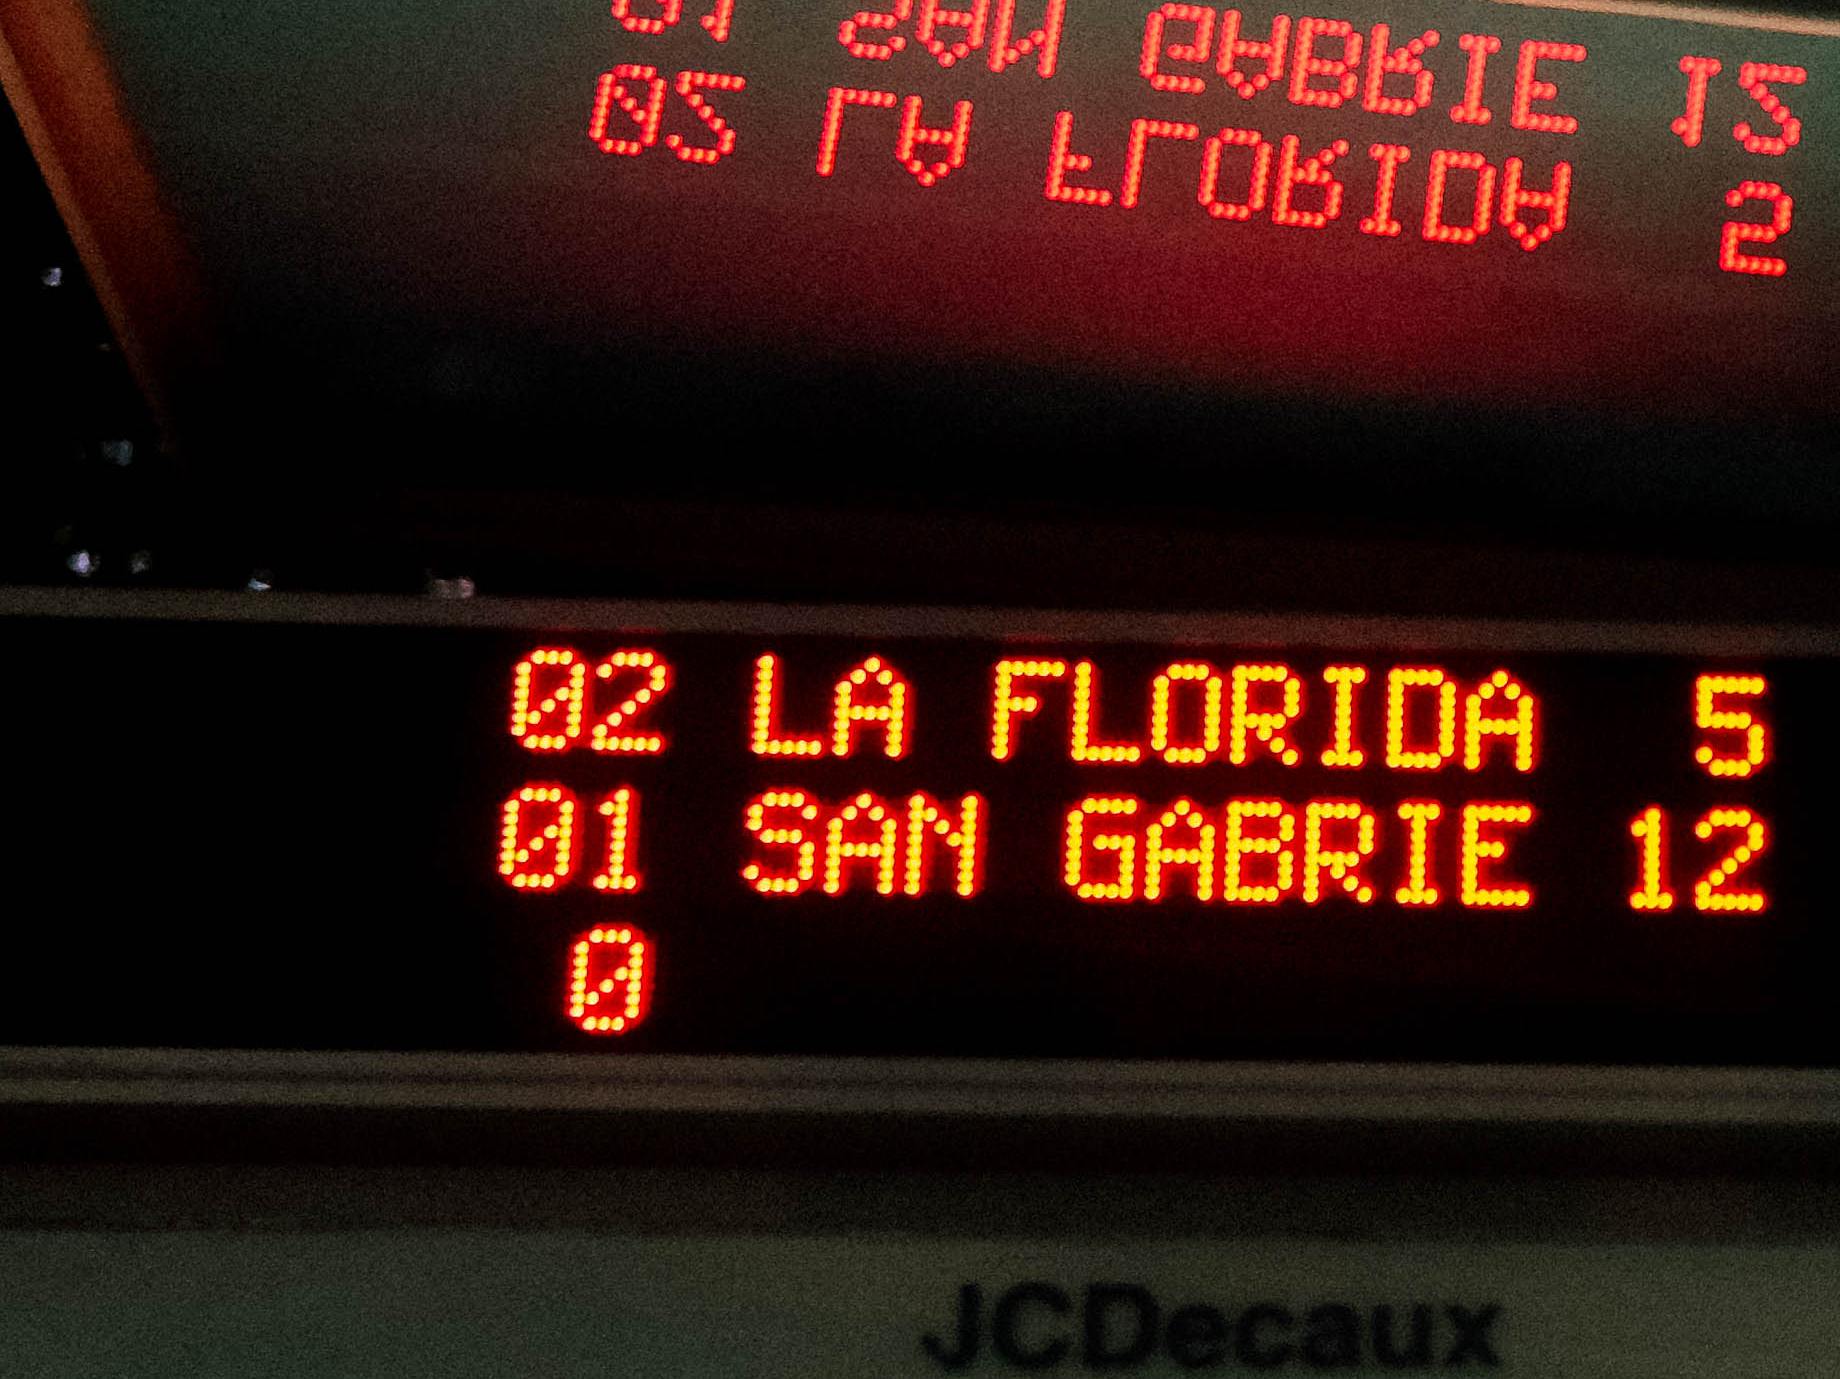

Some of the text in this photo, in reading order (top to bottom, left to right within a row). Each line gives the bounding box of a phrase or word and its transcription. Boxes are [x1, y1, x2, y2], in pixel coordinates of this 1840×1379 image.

[509, 646, 1770, 779] 02 LA FLORIDA 5
[497, 782, 1768, 914] 01 SAN GABRIE 12
[564, 923, 654, 1035] 0
[919, 1280, 1502, 1374] JCDecaux
